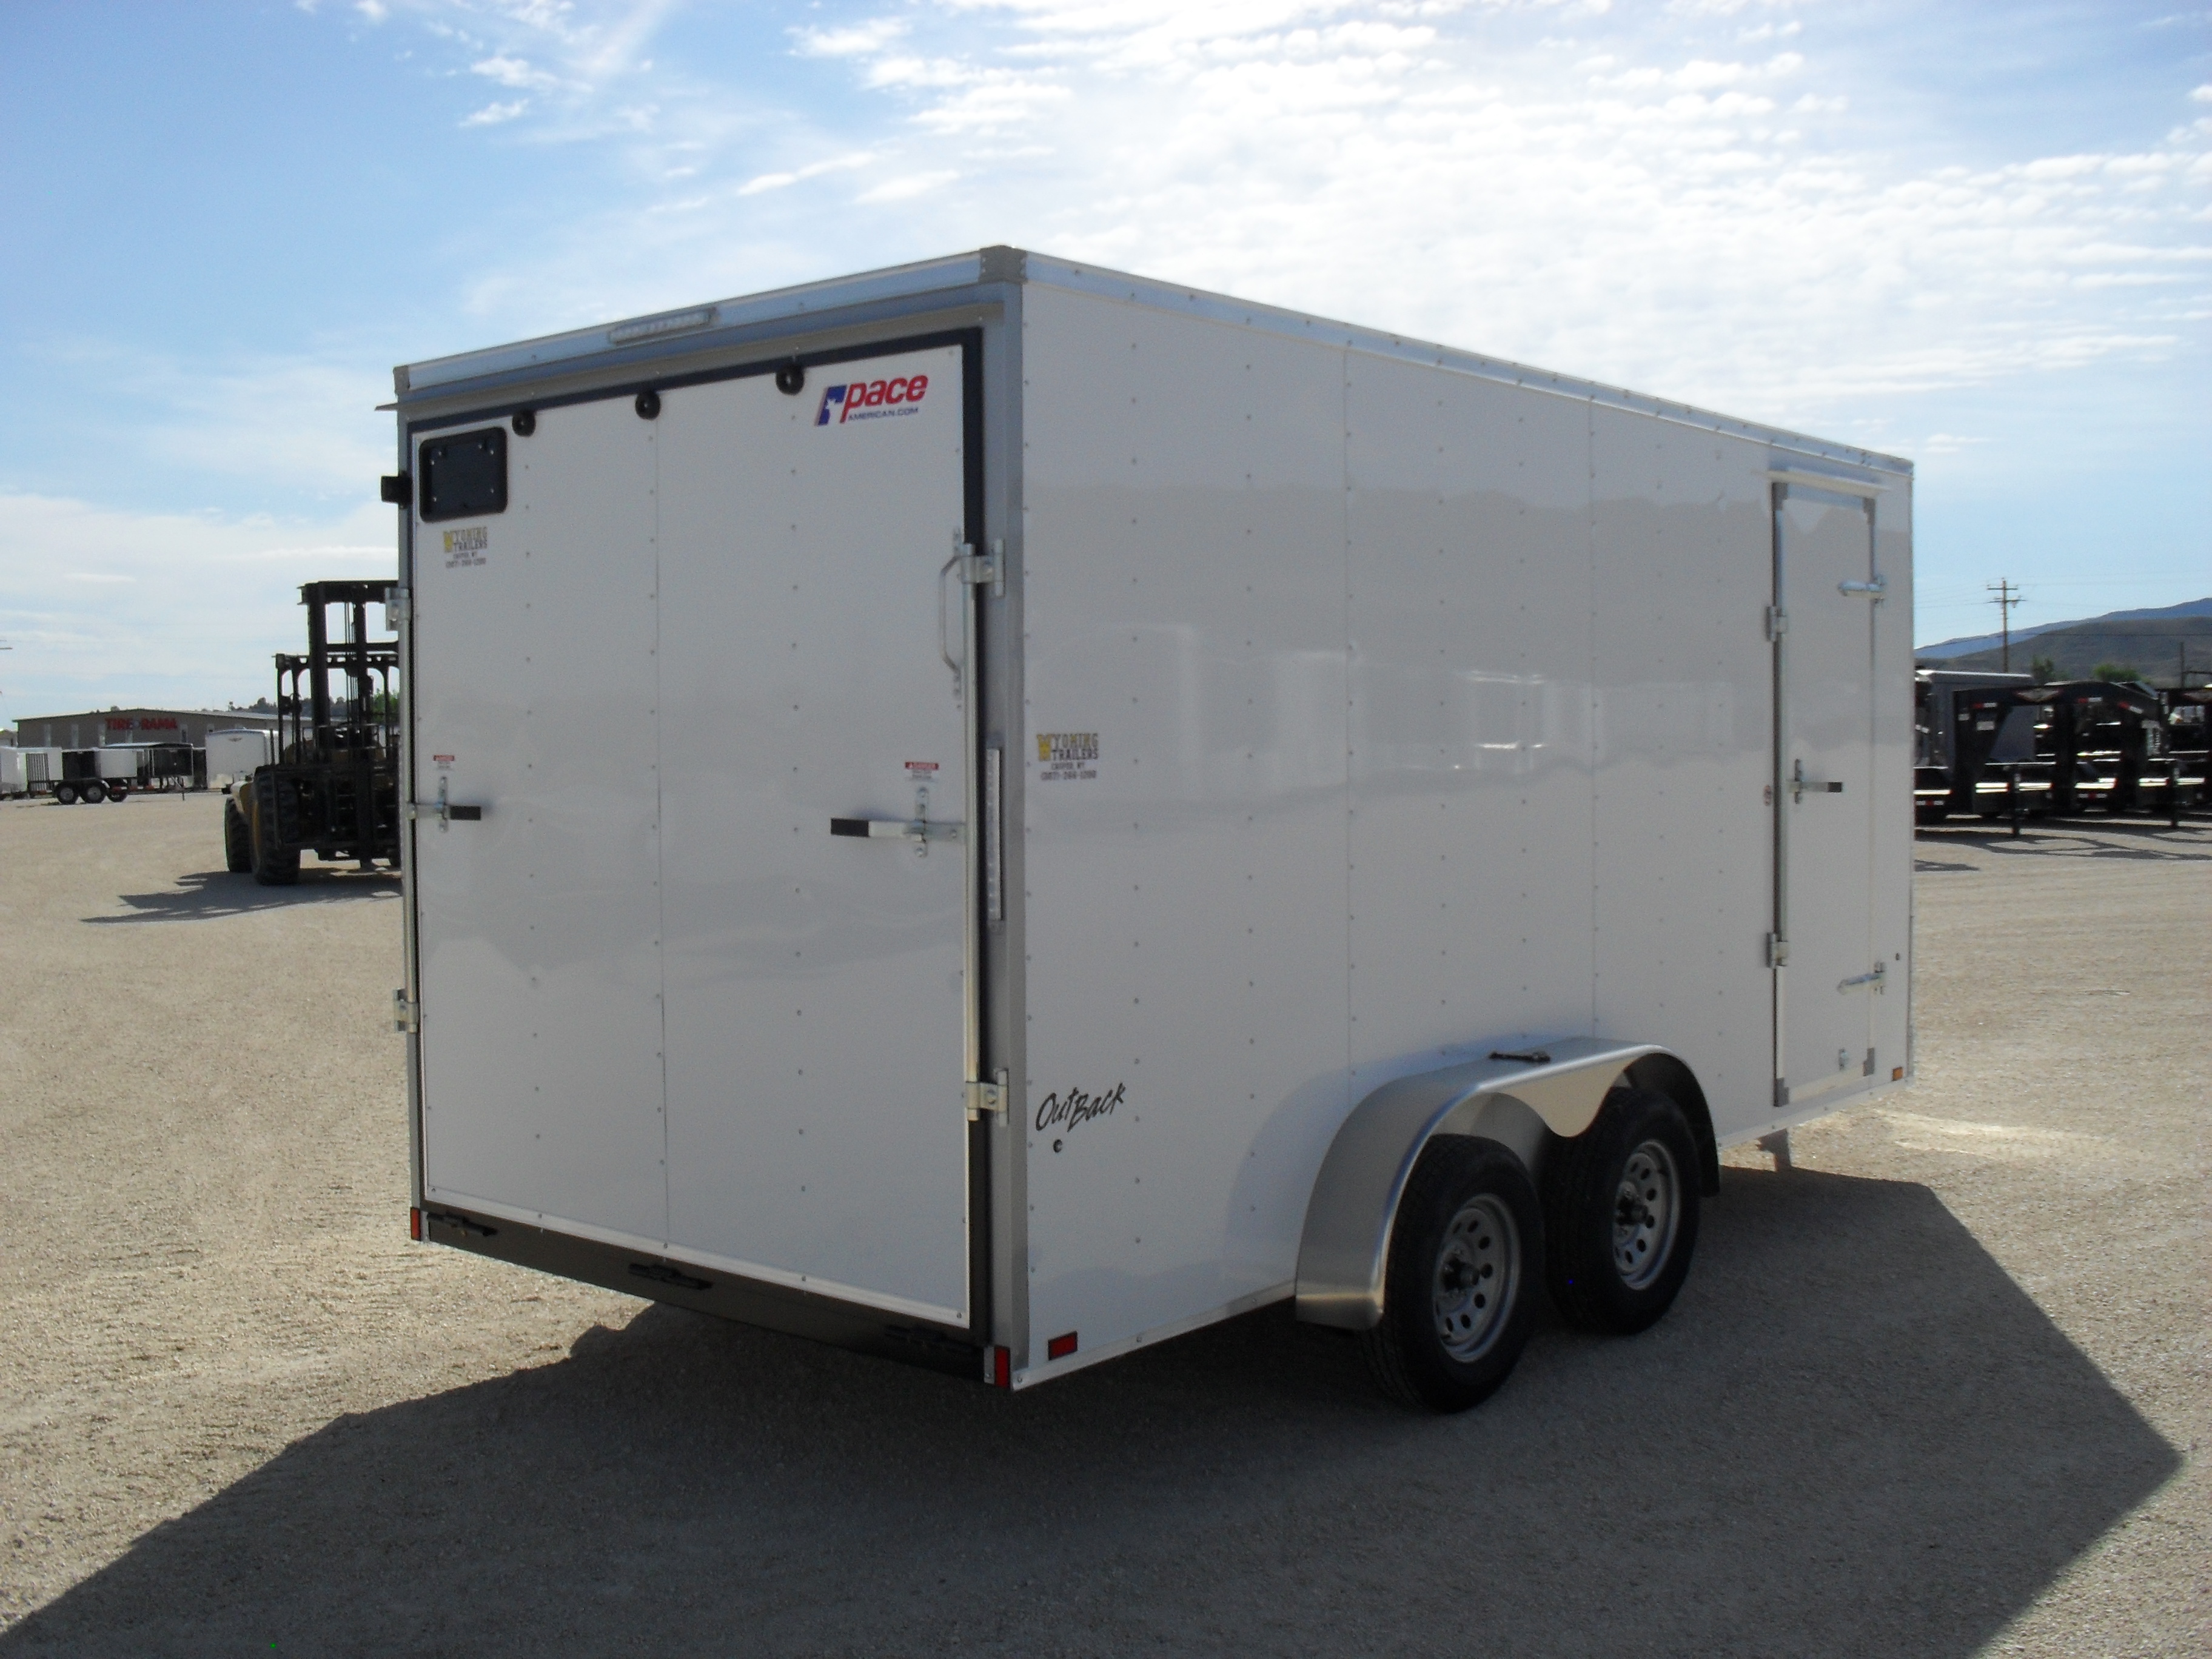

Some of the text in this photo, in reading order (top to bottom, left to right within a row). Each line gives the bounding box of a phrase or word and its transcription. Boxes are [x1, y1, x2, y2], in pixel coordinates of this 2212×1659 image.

[839, 375, 929, 424] pace
[1036, 732, 1098, 762] WYOMING
[1051, 749, 1099, 760] TRAILERS
